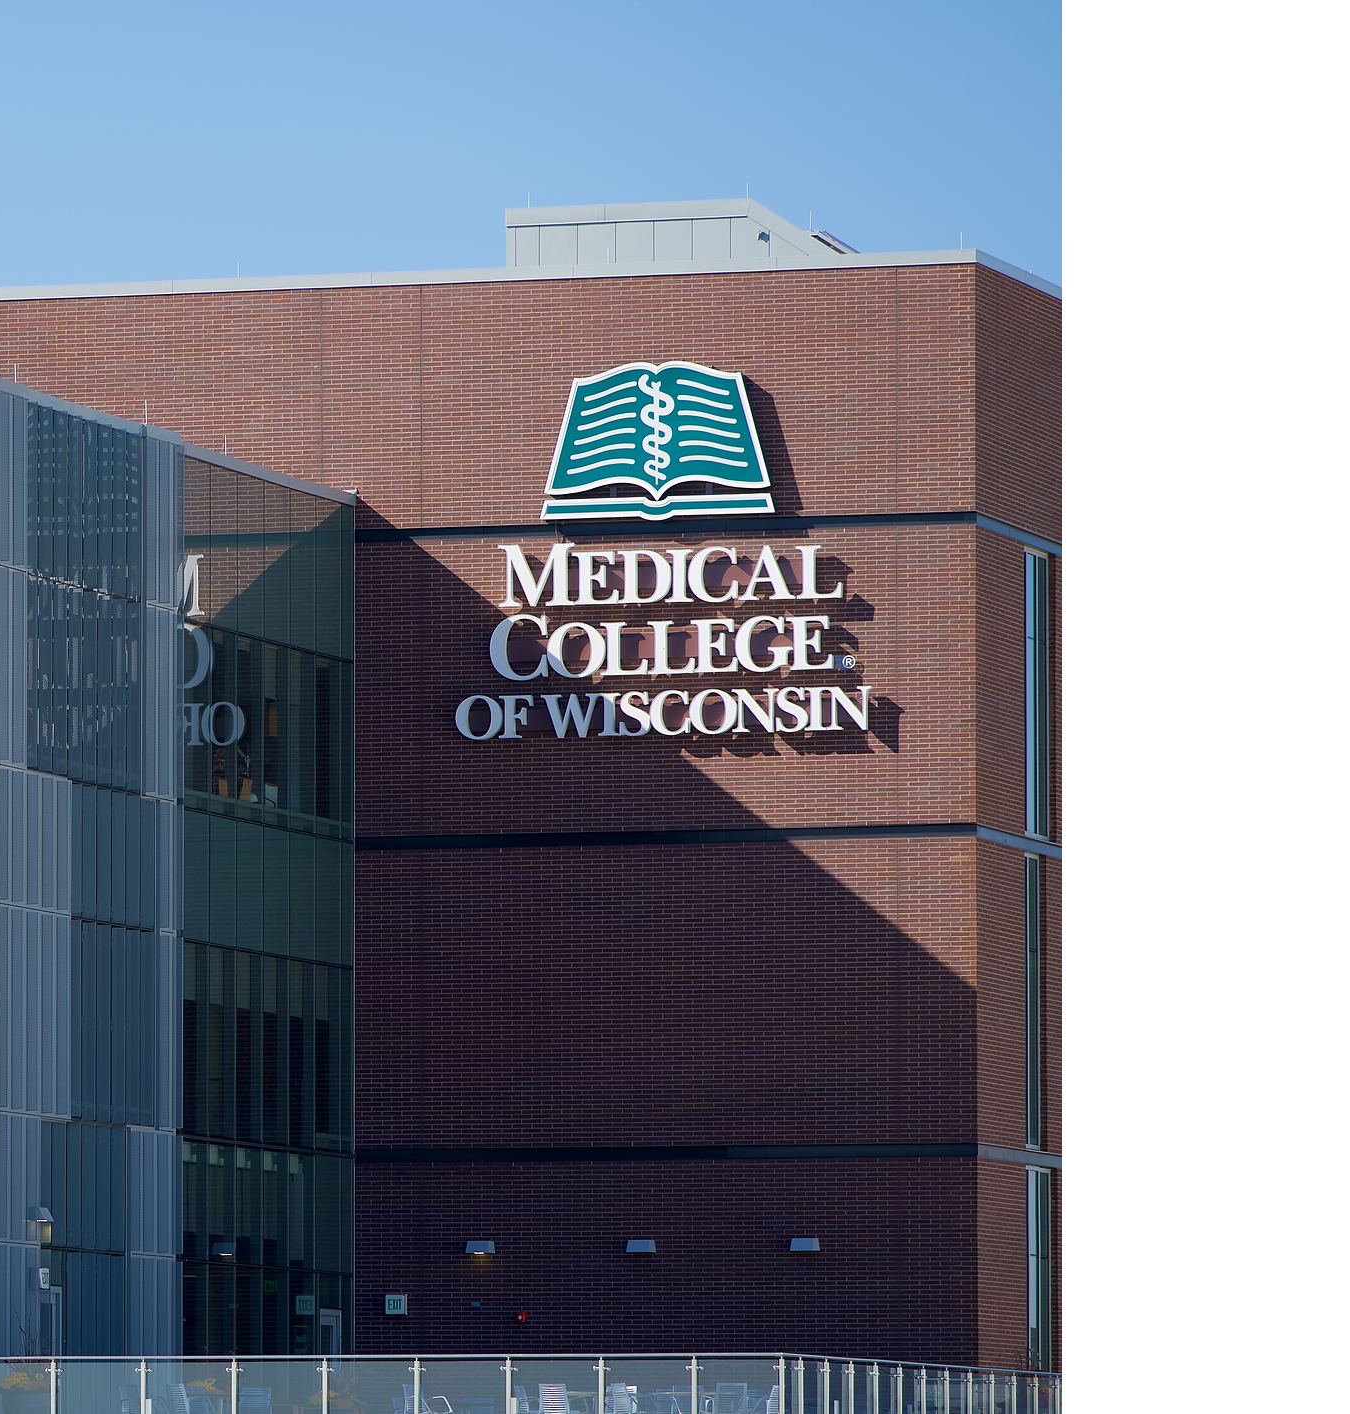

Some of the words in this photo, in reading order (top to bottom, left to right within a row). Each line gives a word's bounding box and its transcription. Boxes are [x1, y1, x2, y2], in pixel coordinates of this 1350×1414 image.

[498, 543, 843, 607] MEDICAL
[455, 694, 534, 741] OF
[540, 685, 872, 739] WISCONSIN
[387, 1298, 402, 1310] EXIT
